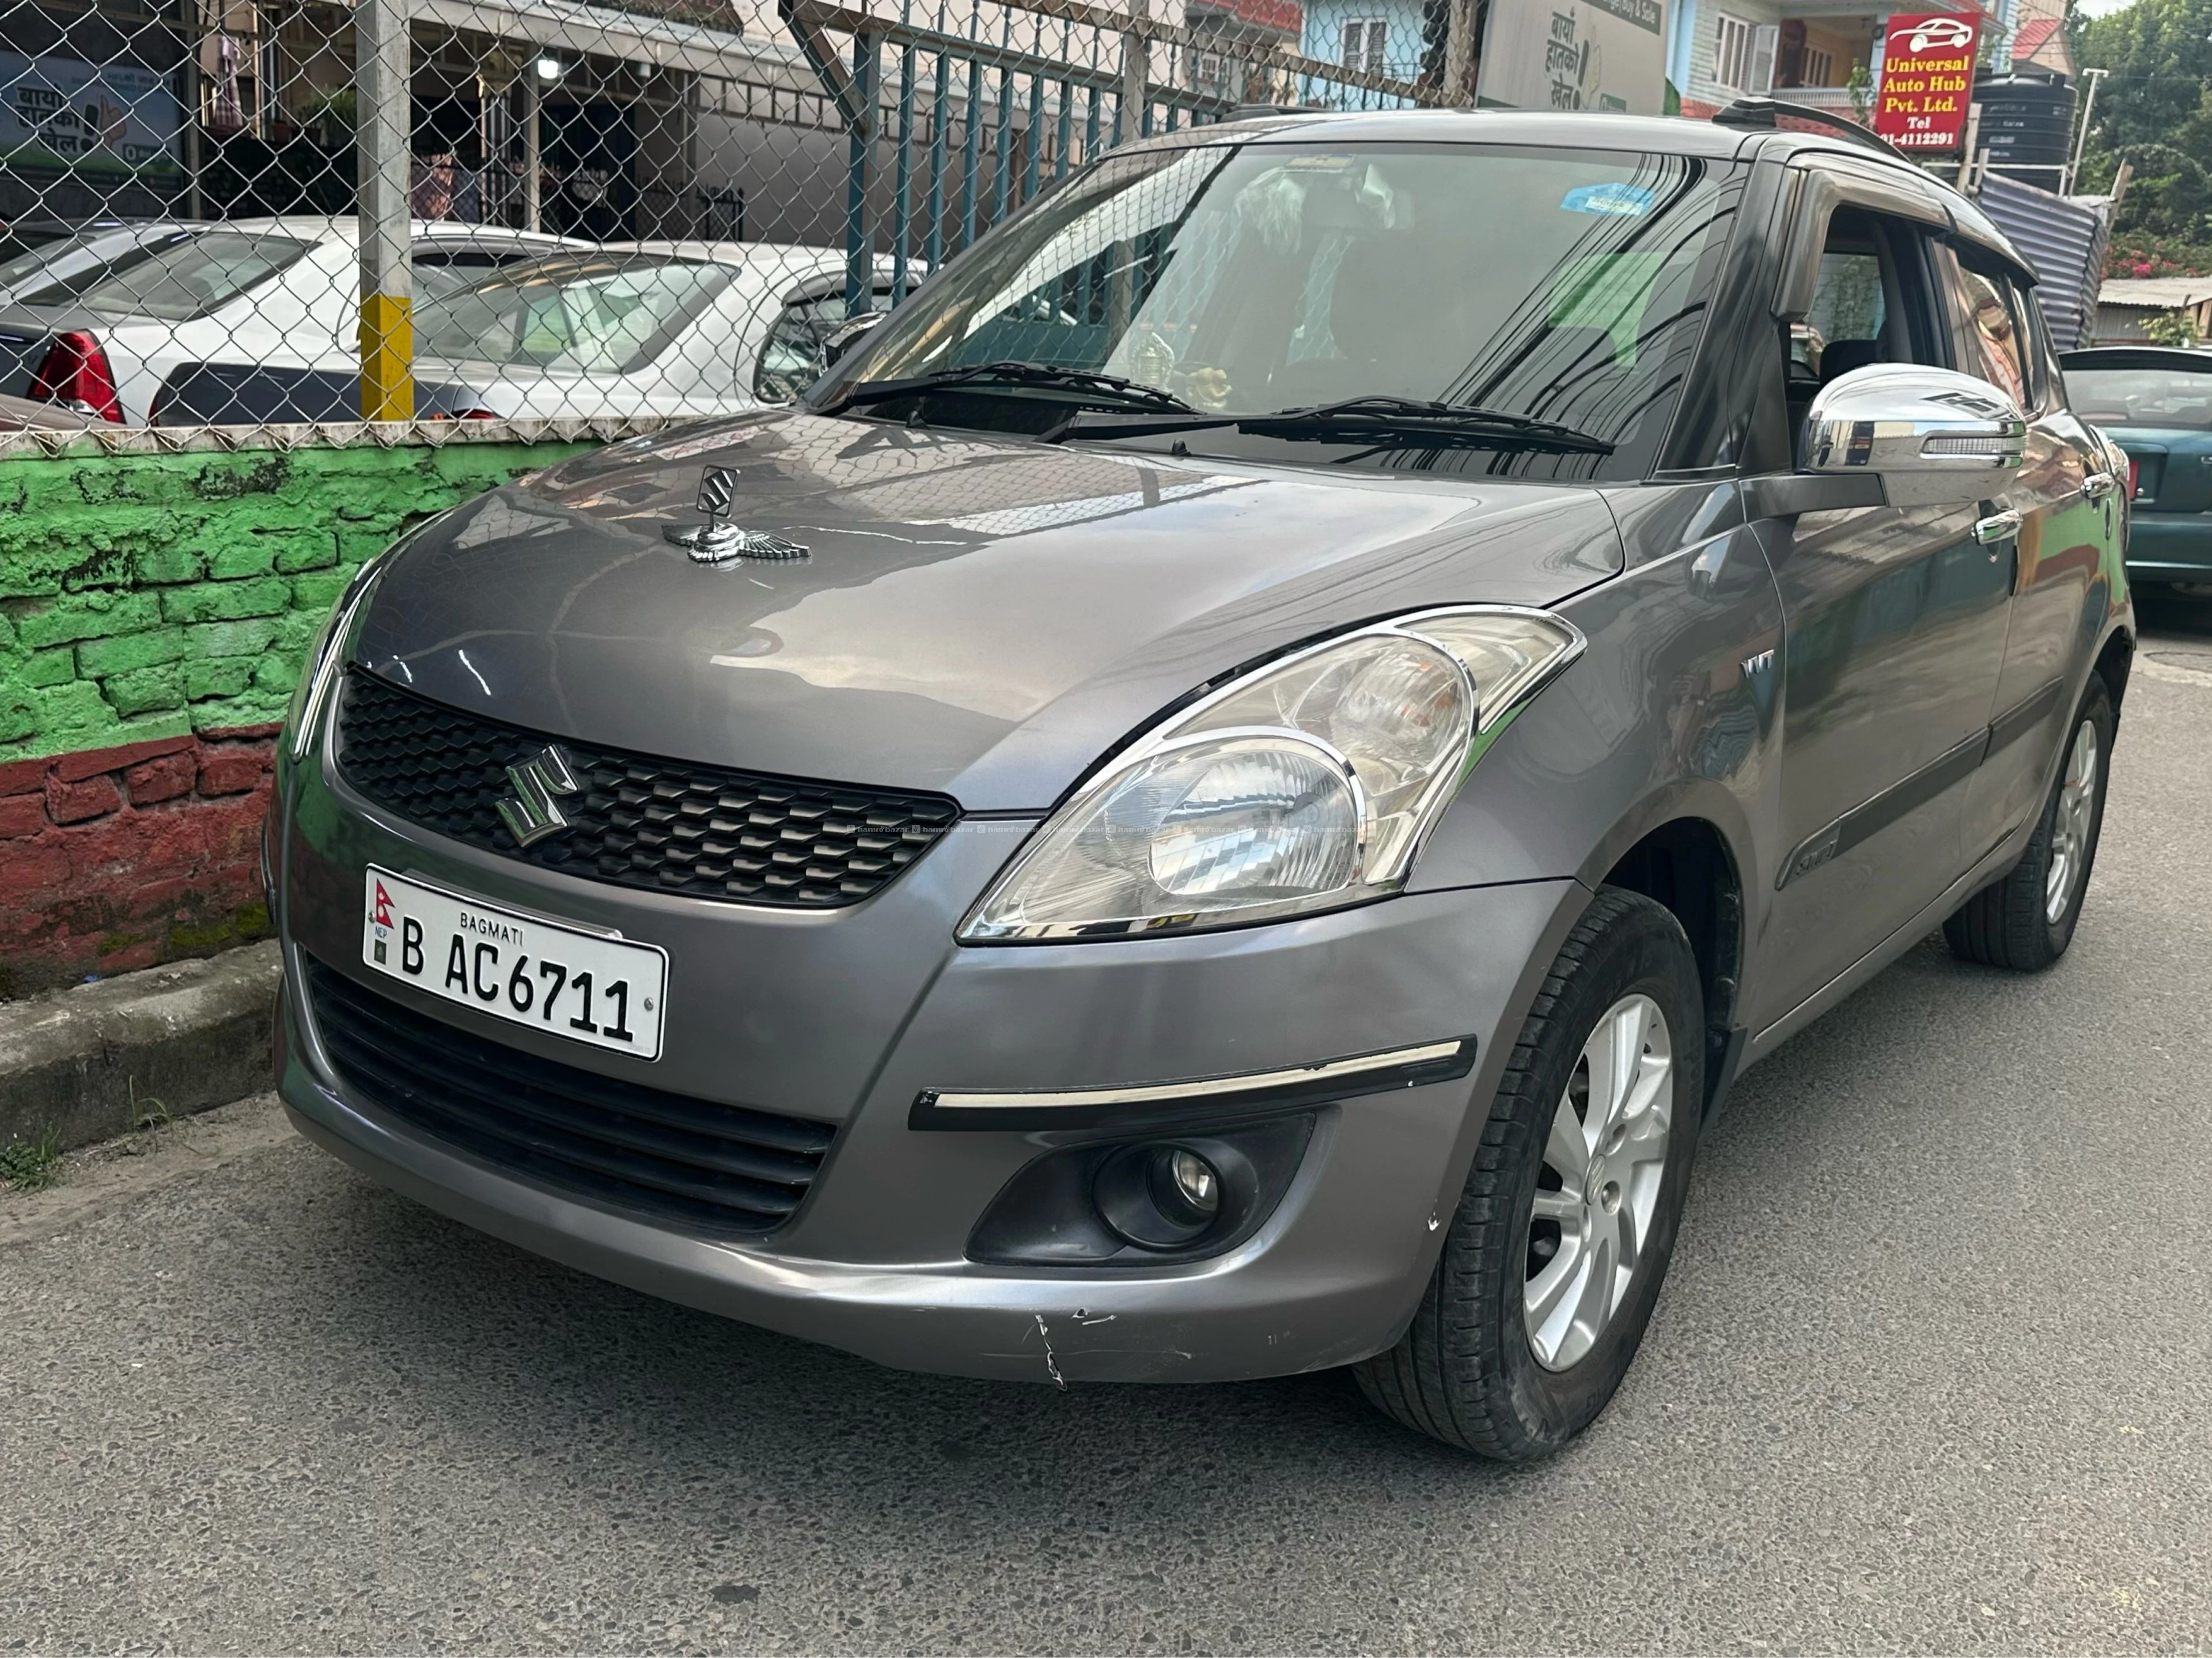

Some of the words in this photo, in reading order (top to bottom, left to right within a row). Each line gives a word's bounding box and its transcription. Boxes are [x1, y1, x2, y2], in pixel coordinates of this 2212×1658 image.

[1641, 2, 1656, 24] Sale
[1545, 39, 1580, 74] हातको
[1886, 55, 1969, 73] Universal
[1551, 72, 1574, 111] खेल
[1883, 77, 1925, 93] Auto
[1929, 75, 1967, 92] Hub
[1884, 97, 1919, 113] Pvt.
[1922, 96, 1958, 112] Ltd.
[1907, 116, 1931, 130] Tel
[375, 925, 387, 939] NEP
[460, 912, 524, 946] BAGMATI
[403, 916, 425, 975] B
